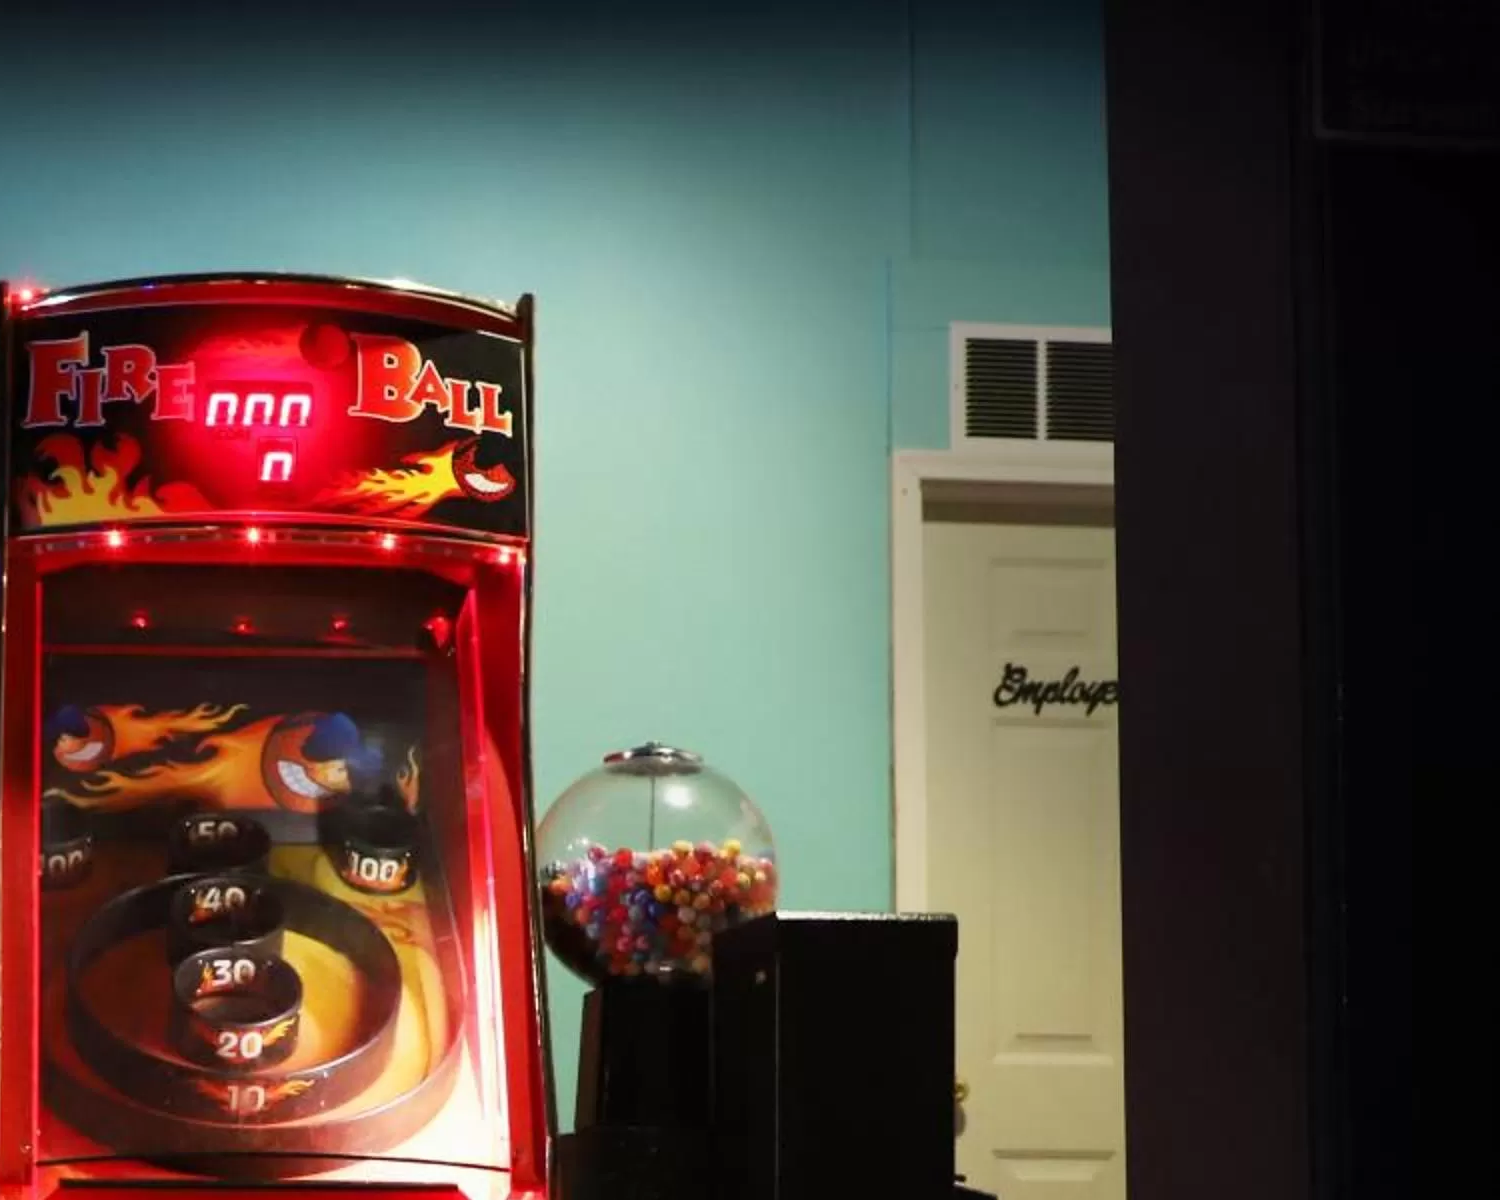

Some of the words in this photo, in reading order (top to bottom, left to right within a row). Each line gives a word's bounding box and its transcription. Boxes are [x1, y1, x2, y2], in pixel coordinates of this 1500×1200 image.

[21, 329, 196, 428] FIRE
[349, 332, 513, 437] BALL
[350, 850, 399, 882] 100
[201, 886, 246, 912] 40
[213, 959, 256, 986] 30
[216, 1031, 264, 1060] 20
[227, 1084, 266, 1113] 10
